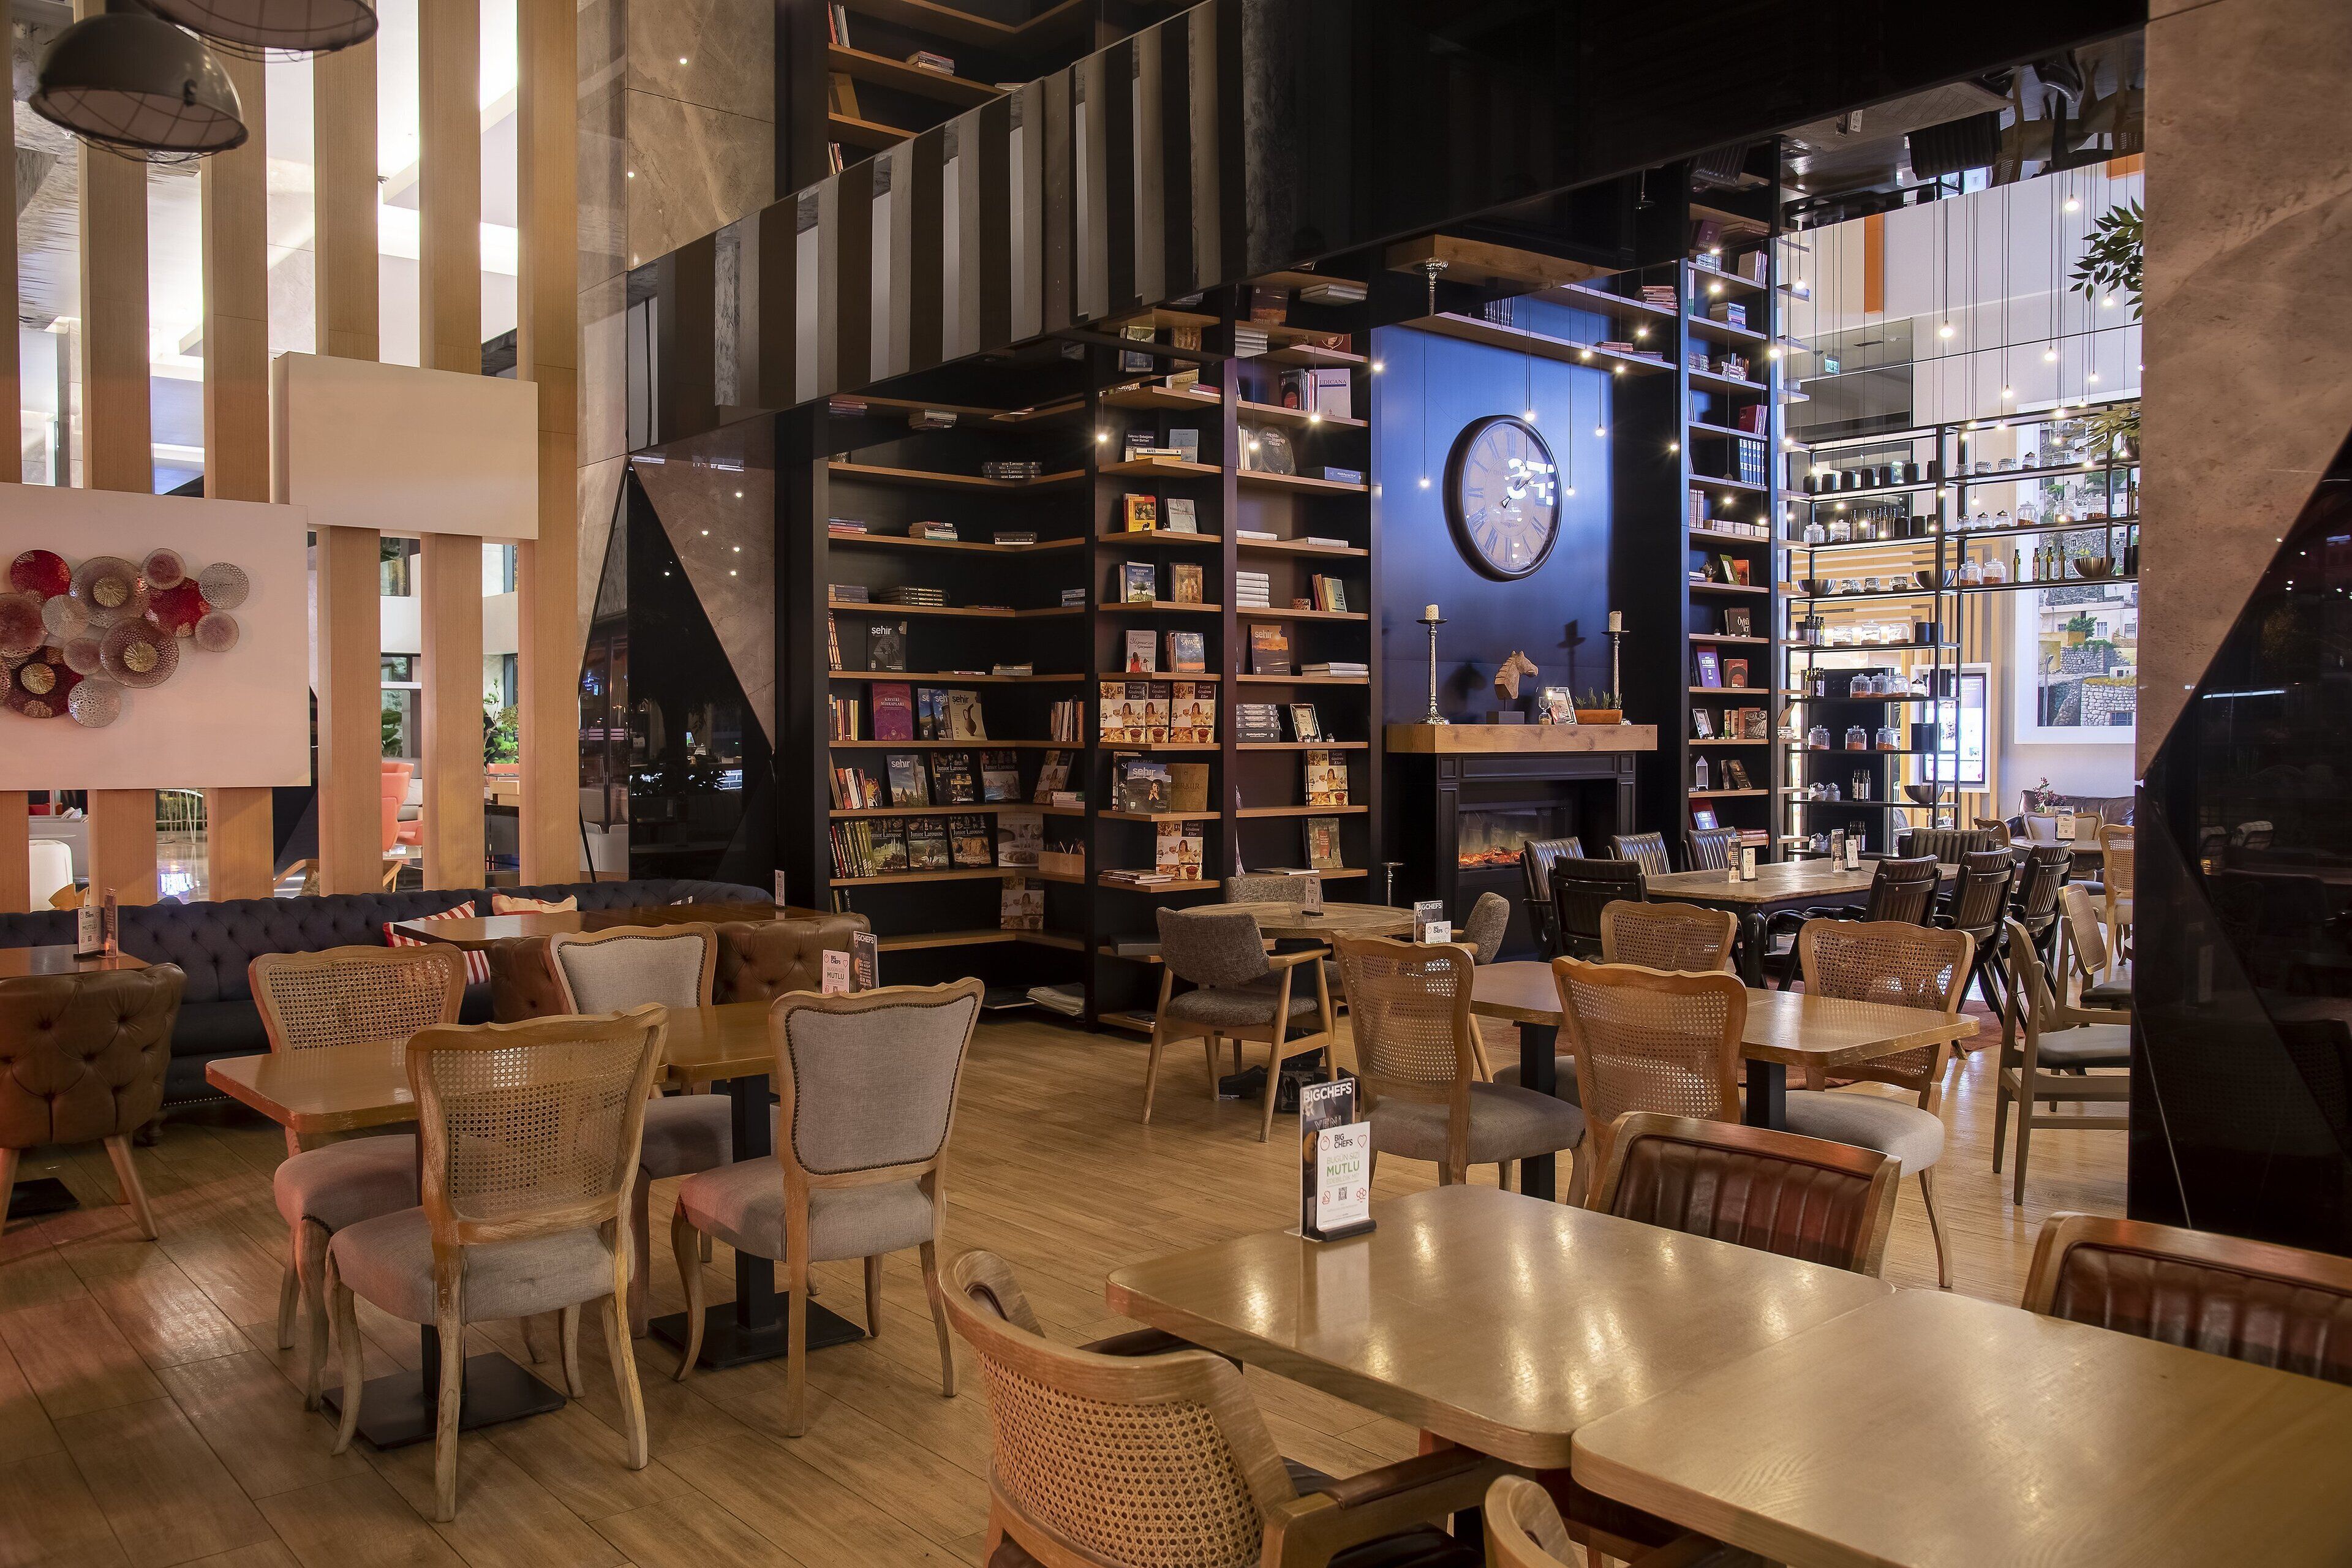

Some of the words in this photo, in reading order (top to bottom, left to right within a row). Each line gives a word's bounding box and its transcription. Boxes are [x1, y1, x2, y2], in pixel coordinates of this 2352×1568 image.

[827, 971, 845, 980] MUTLU
[1303, 1082, 1352, 1103] BIGCHEFS
[1334, 1139, 1354, 1148] CHEFS
[1327, 1160, 1360, 1177] MUTLU
